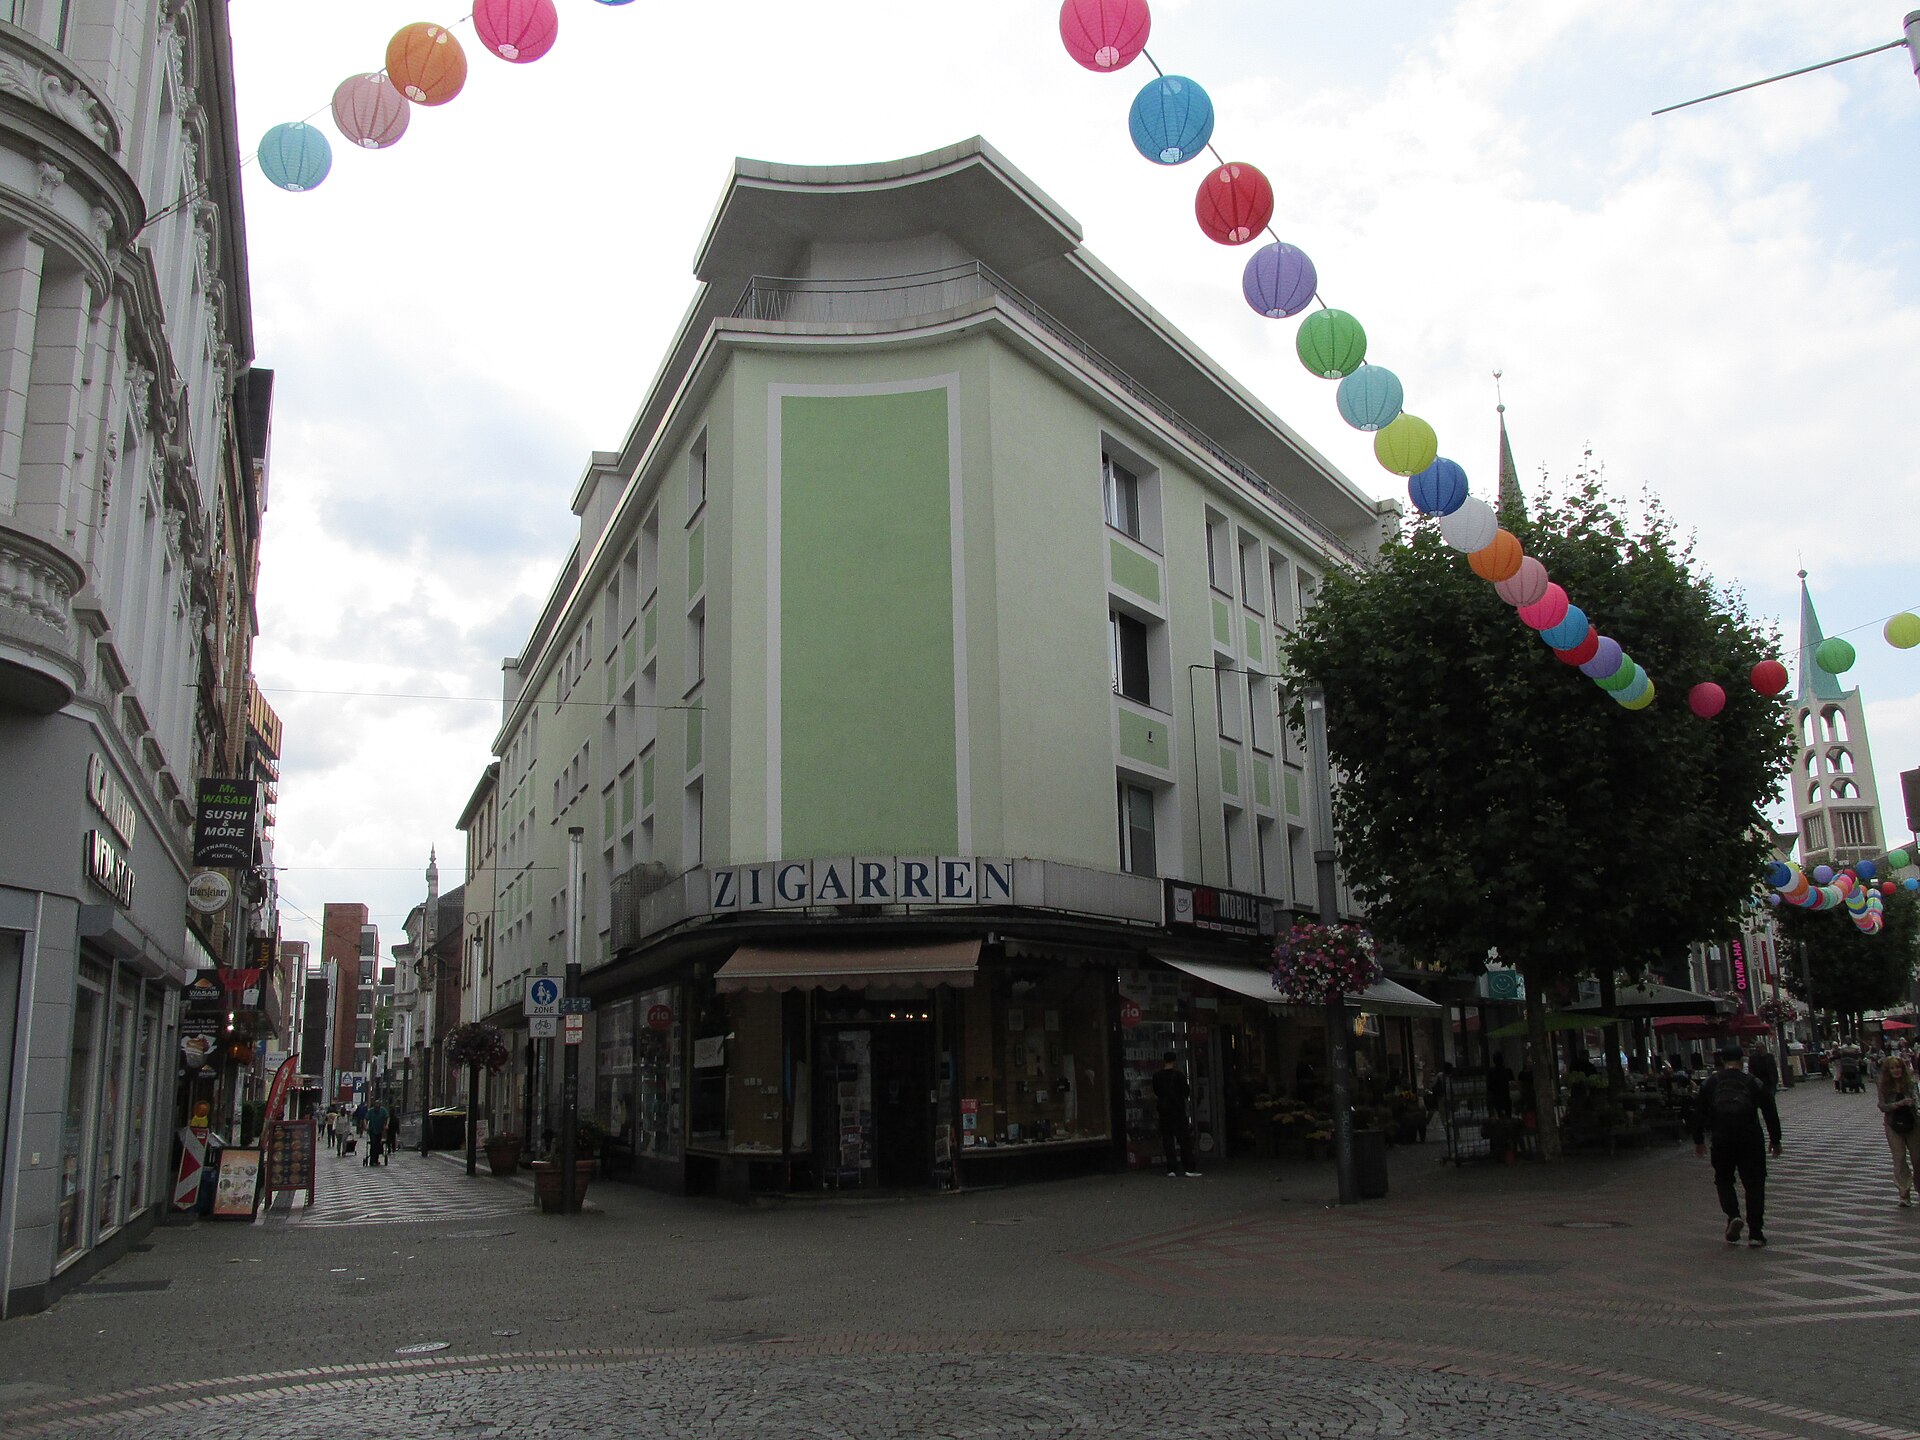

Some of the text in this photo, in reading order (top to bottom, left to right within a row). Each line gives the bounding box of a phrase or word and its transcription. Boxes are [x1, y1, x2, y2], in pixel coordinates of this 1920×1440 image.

[219, 783, 236, 794] Mr.
[202, 794, 253, 806] WASABI
[204, 809, 248, 821] SUSHI
[222, 819, 230, 827] &
[204, 826, 246, 838] MORE
[713, 860, 1013, 908] ZIGARREN
[189, 886, 228, 900] Warsteiner
[1218, 892, 1258, 923] MOBILE
[1732, 939, 1747, 990] OLYMP&HA
[188, 989, 221, 998] WASABI
[533, 1006, 555, 1014] ZONE
[649, 1008, 670, 1021] ria
[1120, 1003, 1140, 1018] ria
